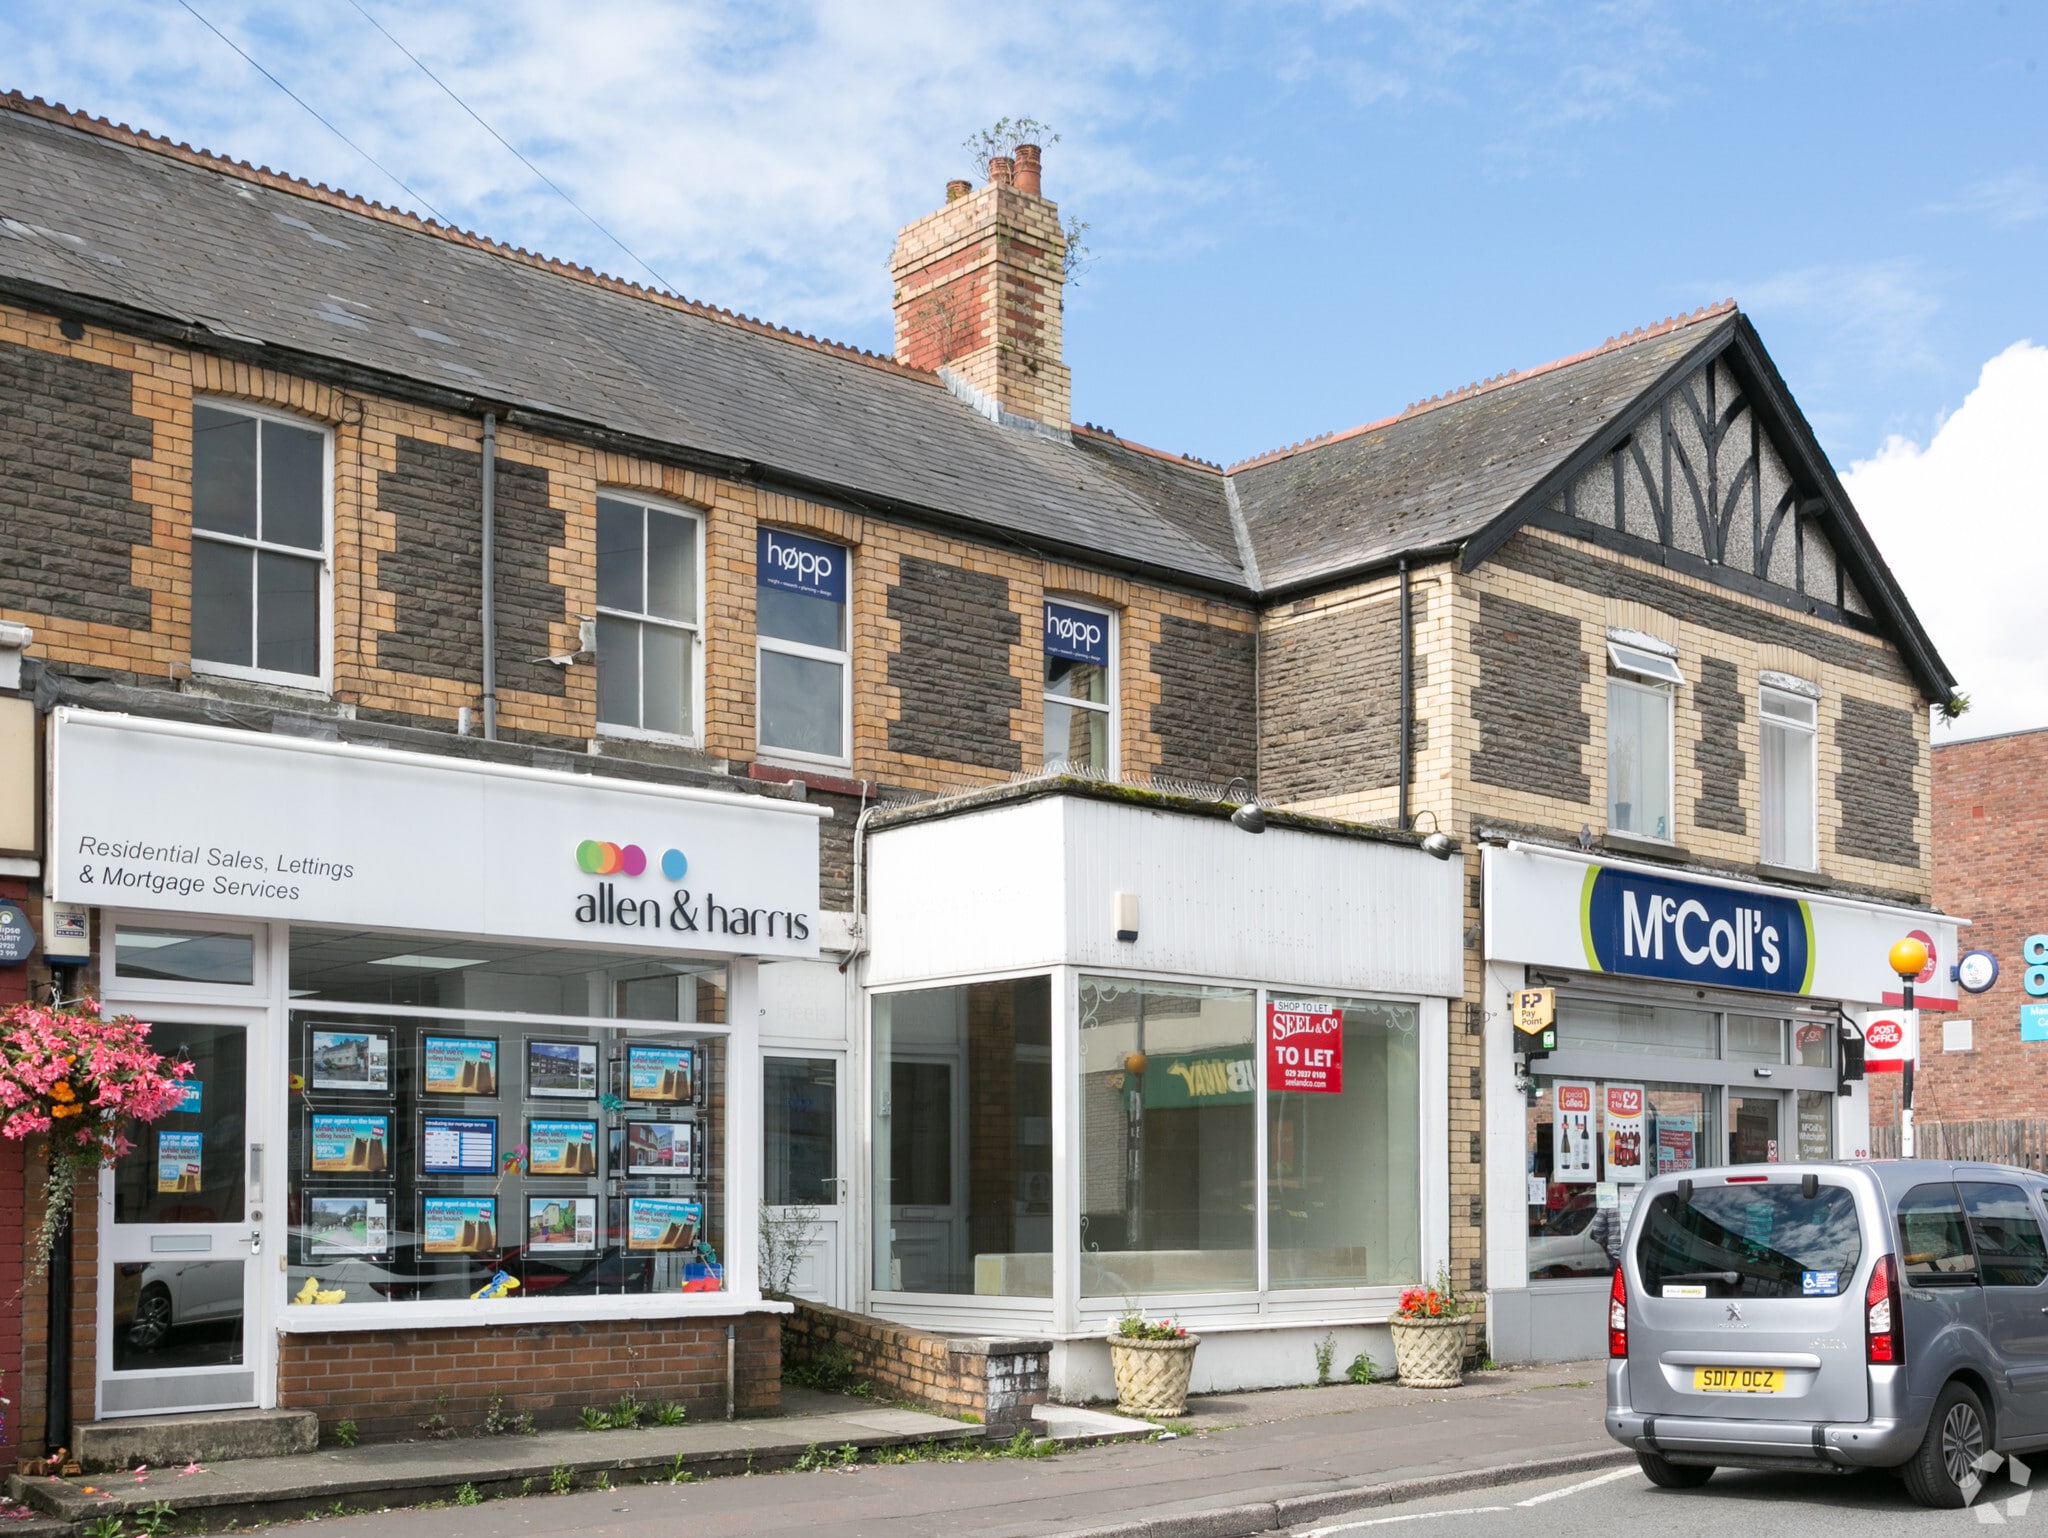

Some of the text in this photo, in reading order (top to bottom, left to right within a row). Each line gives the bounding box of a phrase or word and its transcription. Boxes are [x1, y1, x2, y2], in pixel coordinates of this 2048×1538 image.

[768, 532, 832, 586] høpp
[1047, 605, 1101, 652] høpp
[78, 835, 355, 880] Residential Sales, Lettings
[79, 865, 300, 901] & Mortgage Services
[575, 882, 809, 940] allen & harris
[1622, 889, 1781, 974] McColl's
[1278, 1001, 1328, 1013] SHOP TO LET
[1522, 1010, 1536, 1018] Pay
[1522, 1018, 1543, 1026] Point
[1873, 1025, 1896, 1034] POST
[1869, 1033, 1900, 1044] OFFICE
[1275, 1046, 1334, 1068] TO LET
[1285, 1069, 1296, 1077] 029
[1285, 1078, 1327, 1088] seelandco.com
[1622, 1090, 1639, 1110] £2
[1703, 1370, 1774, 1387] SD17 OCZ
